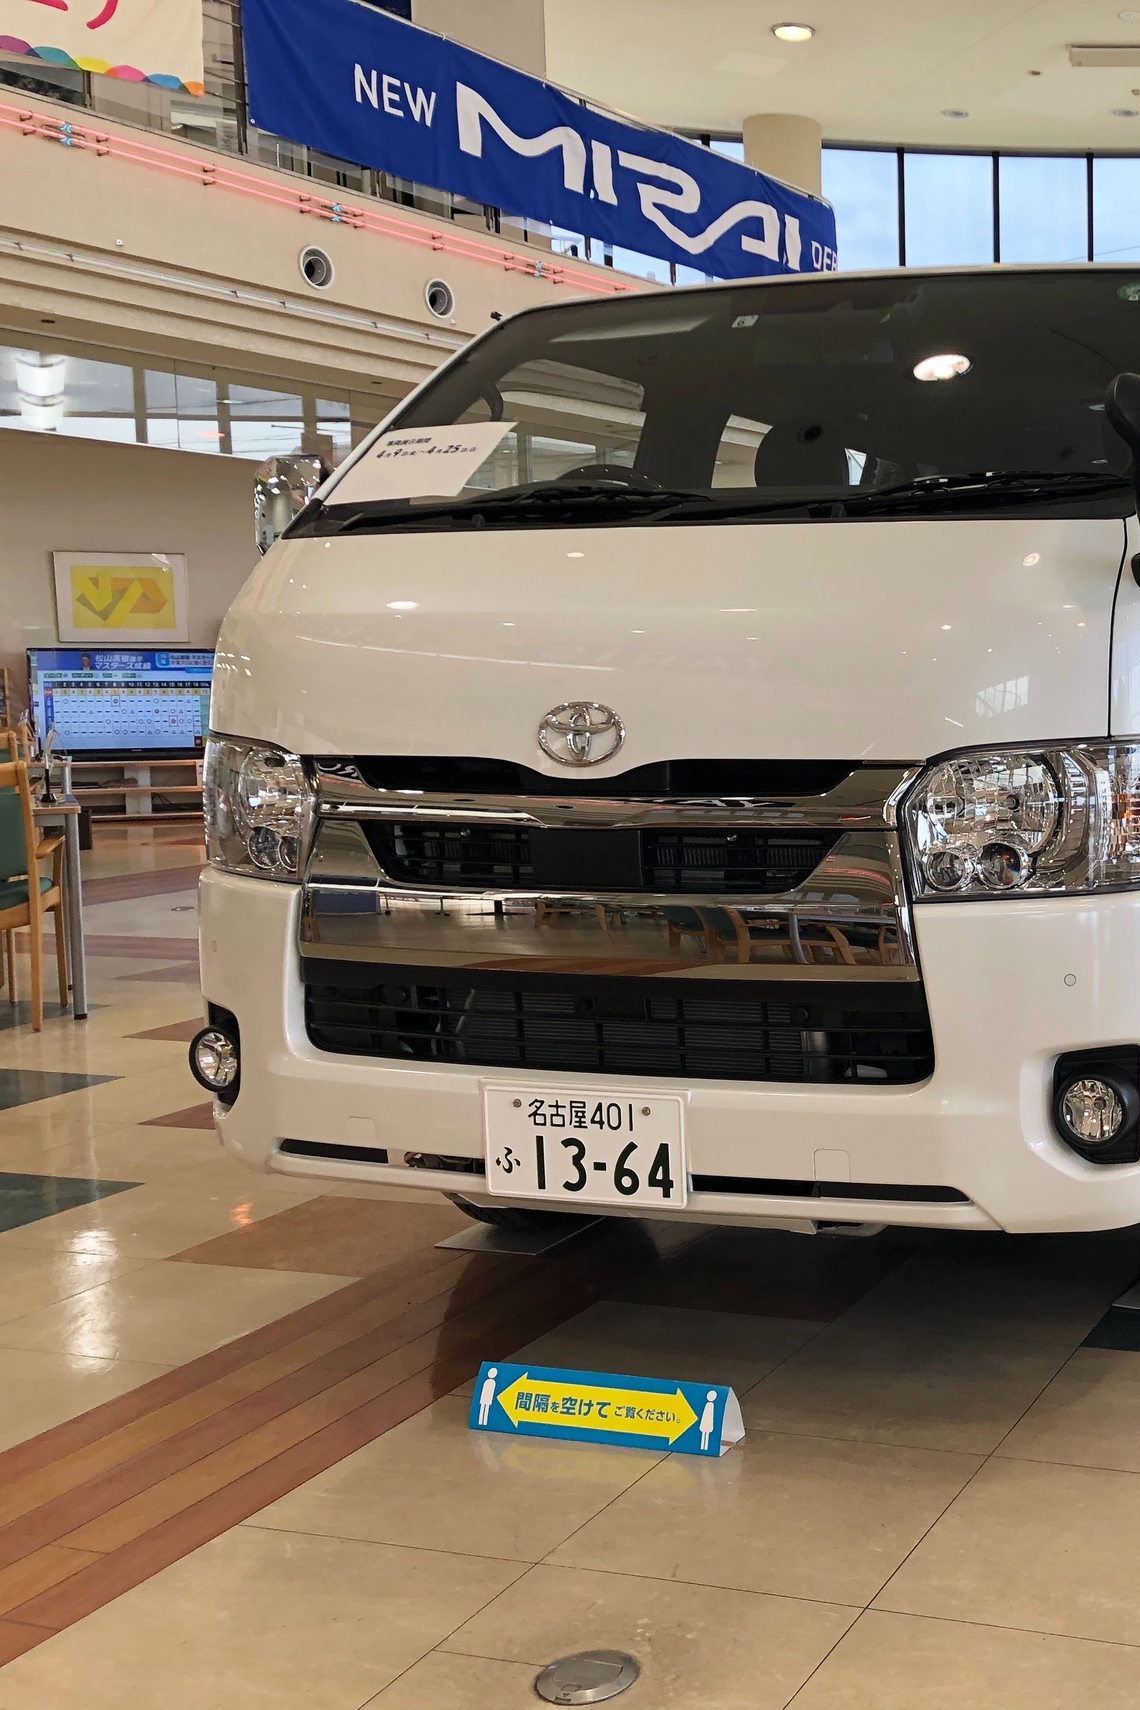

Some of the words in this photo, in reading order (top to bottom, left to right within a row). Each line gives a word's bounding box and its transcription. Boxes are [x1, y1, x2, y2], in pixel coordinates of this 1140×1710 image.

[354, 63, 436, 127] NEW
[456, 81, 801, 271] MIRAI
[495, 1146, 521, 1174] ふ
[535, 1135, 674, 1199] 13-64
